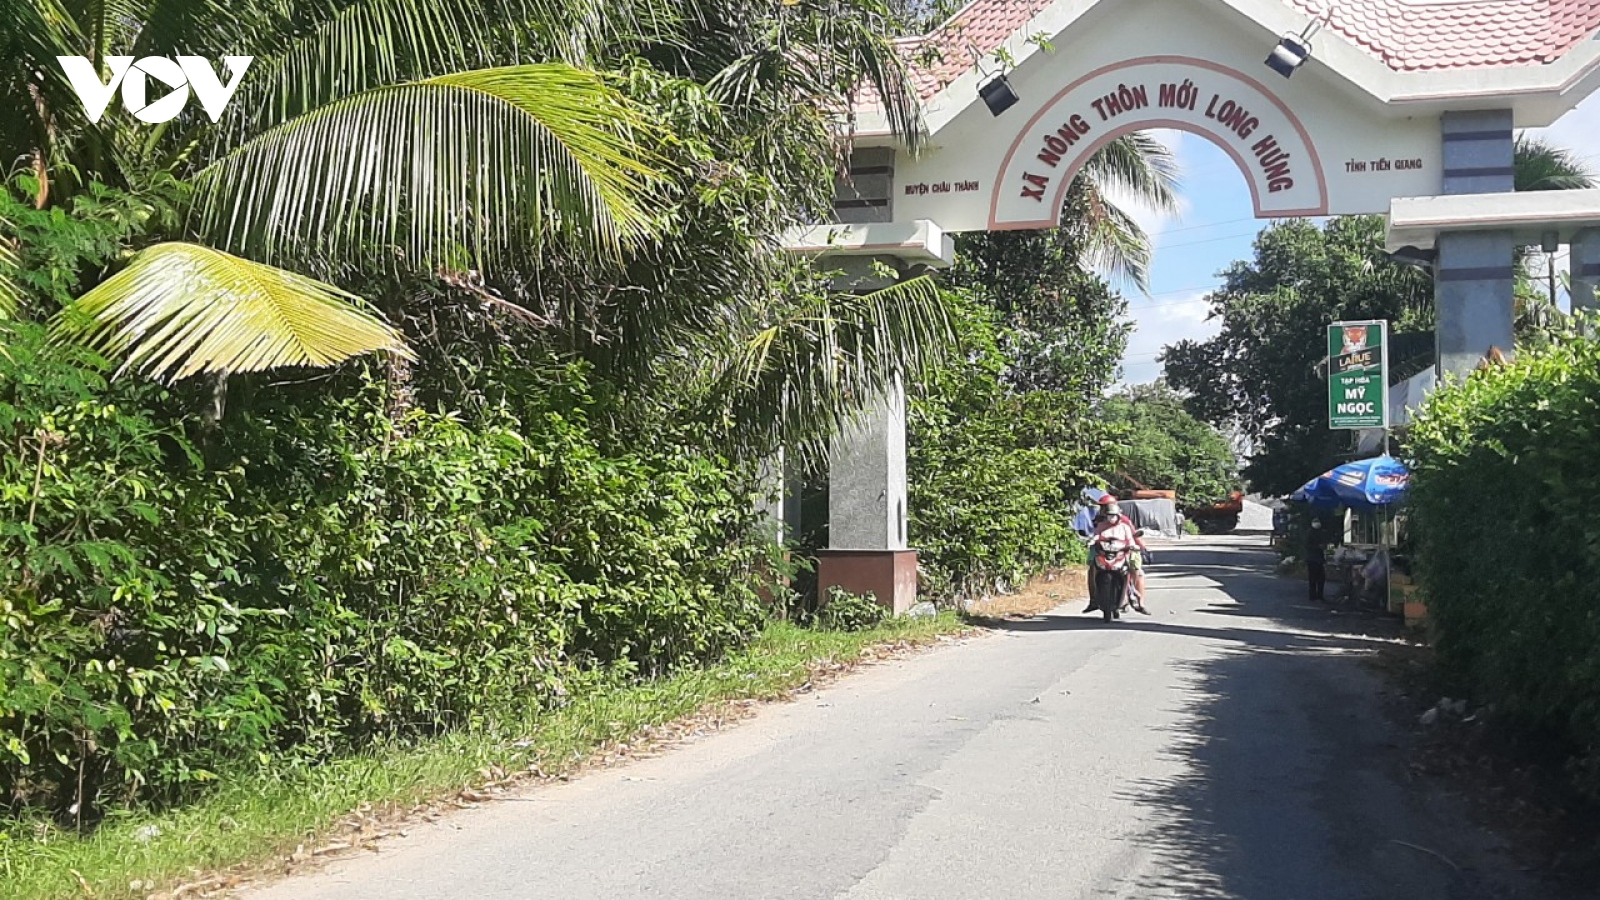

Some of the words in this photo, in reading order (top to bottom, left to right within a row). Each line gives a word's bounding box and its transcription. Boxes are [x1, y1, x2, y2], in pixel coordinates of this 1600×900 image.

[1020, 171, 1049, 202] XÃ
[1037, 114, 1091, 168] NÔNG
[1091, 84, 1149, 121] THÔN
[1159, 78, 1199, 111] MỚI
[1205, 94, 1259, 140] LONG
[1251, 134, 1294, 193] HƯNG
[1394, 158, 1423, 170] GIANG
[932, 181, 951, 193] CHÂU
[1339, 352, 1371, 367] LARUE
[1345, 386, 1366, 399] MỸ
[1337, 402, 1375, 415] NGỌC
